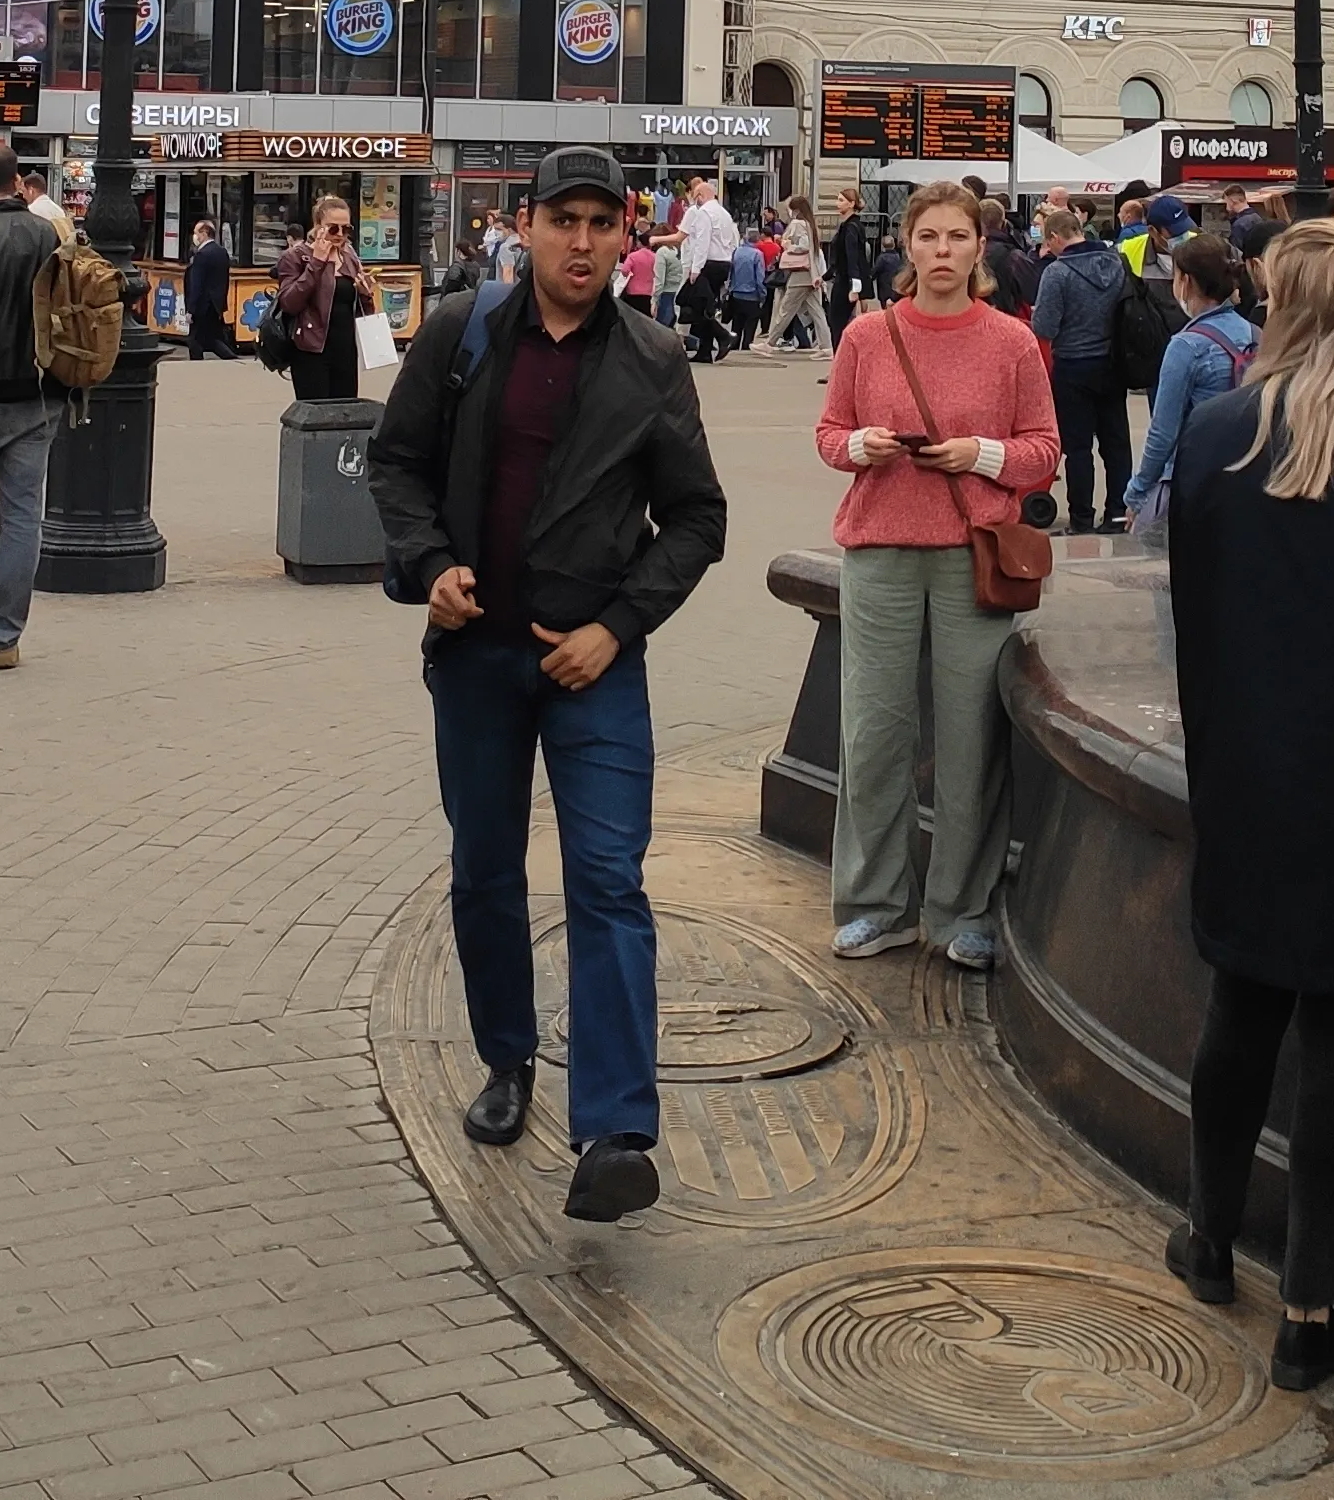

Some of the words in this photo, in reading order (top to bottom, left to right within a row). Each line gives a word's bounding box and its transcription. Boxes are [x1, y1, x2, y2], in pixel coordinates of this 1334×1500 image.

[336, 2, 384, 22] BURGER
[566, 12, 611, 32] BURGER
[337, 13, 386, 39] KING
[567, 23, 613, 47] KING
[1061, 15, 1126, 41] KFC
[85, 103, 240, 127] СВЕНИРЫ
[640, 113, 771, 137] ТРИКОТАЖ
[262, 136, 407, 158] WOW!КОФЕ
[1188, 138, 1268, 158] КофеХауз
[1083, 182, 1116, 193] KFC
